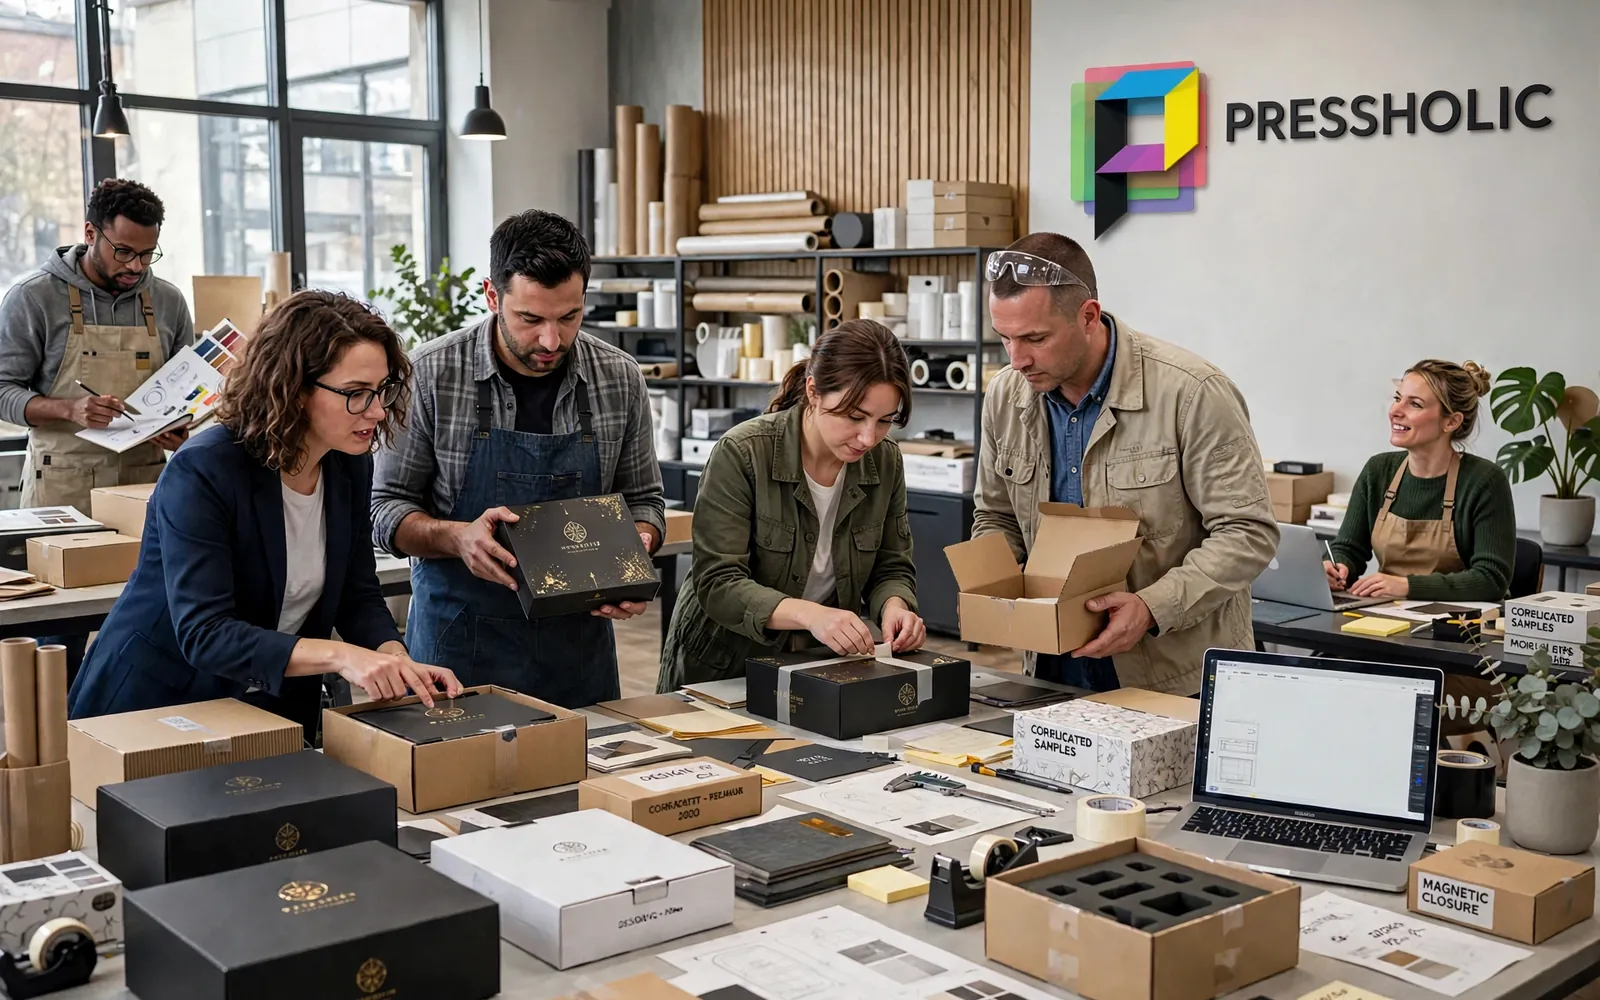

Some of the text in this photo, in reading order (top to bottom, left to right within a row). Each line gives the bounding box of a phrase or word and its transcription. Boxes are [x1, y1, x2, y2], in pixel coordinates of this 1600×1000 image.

[1225, 83, 1553, 143] PRESSHOLIC
[1421, 891, 1480, 916] CLOSURE
[1423, 877, 1489, 905] MAGNETIC
